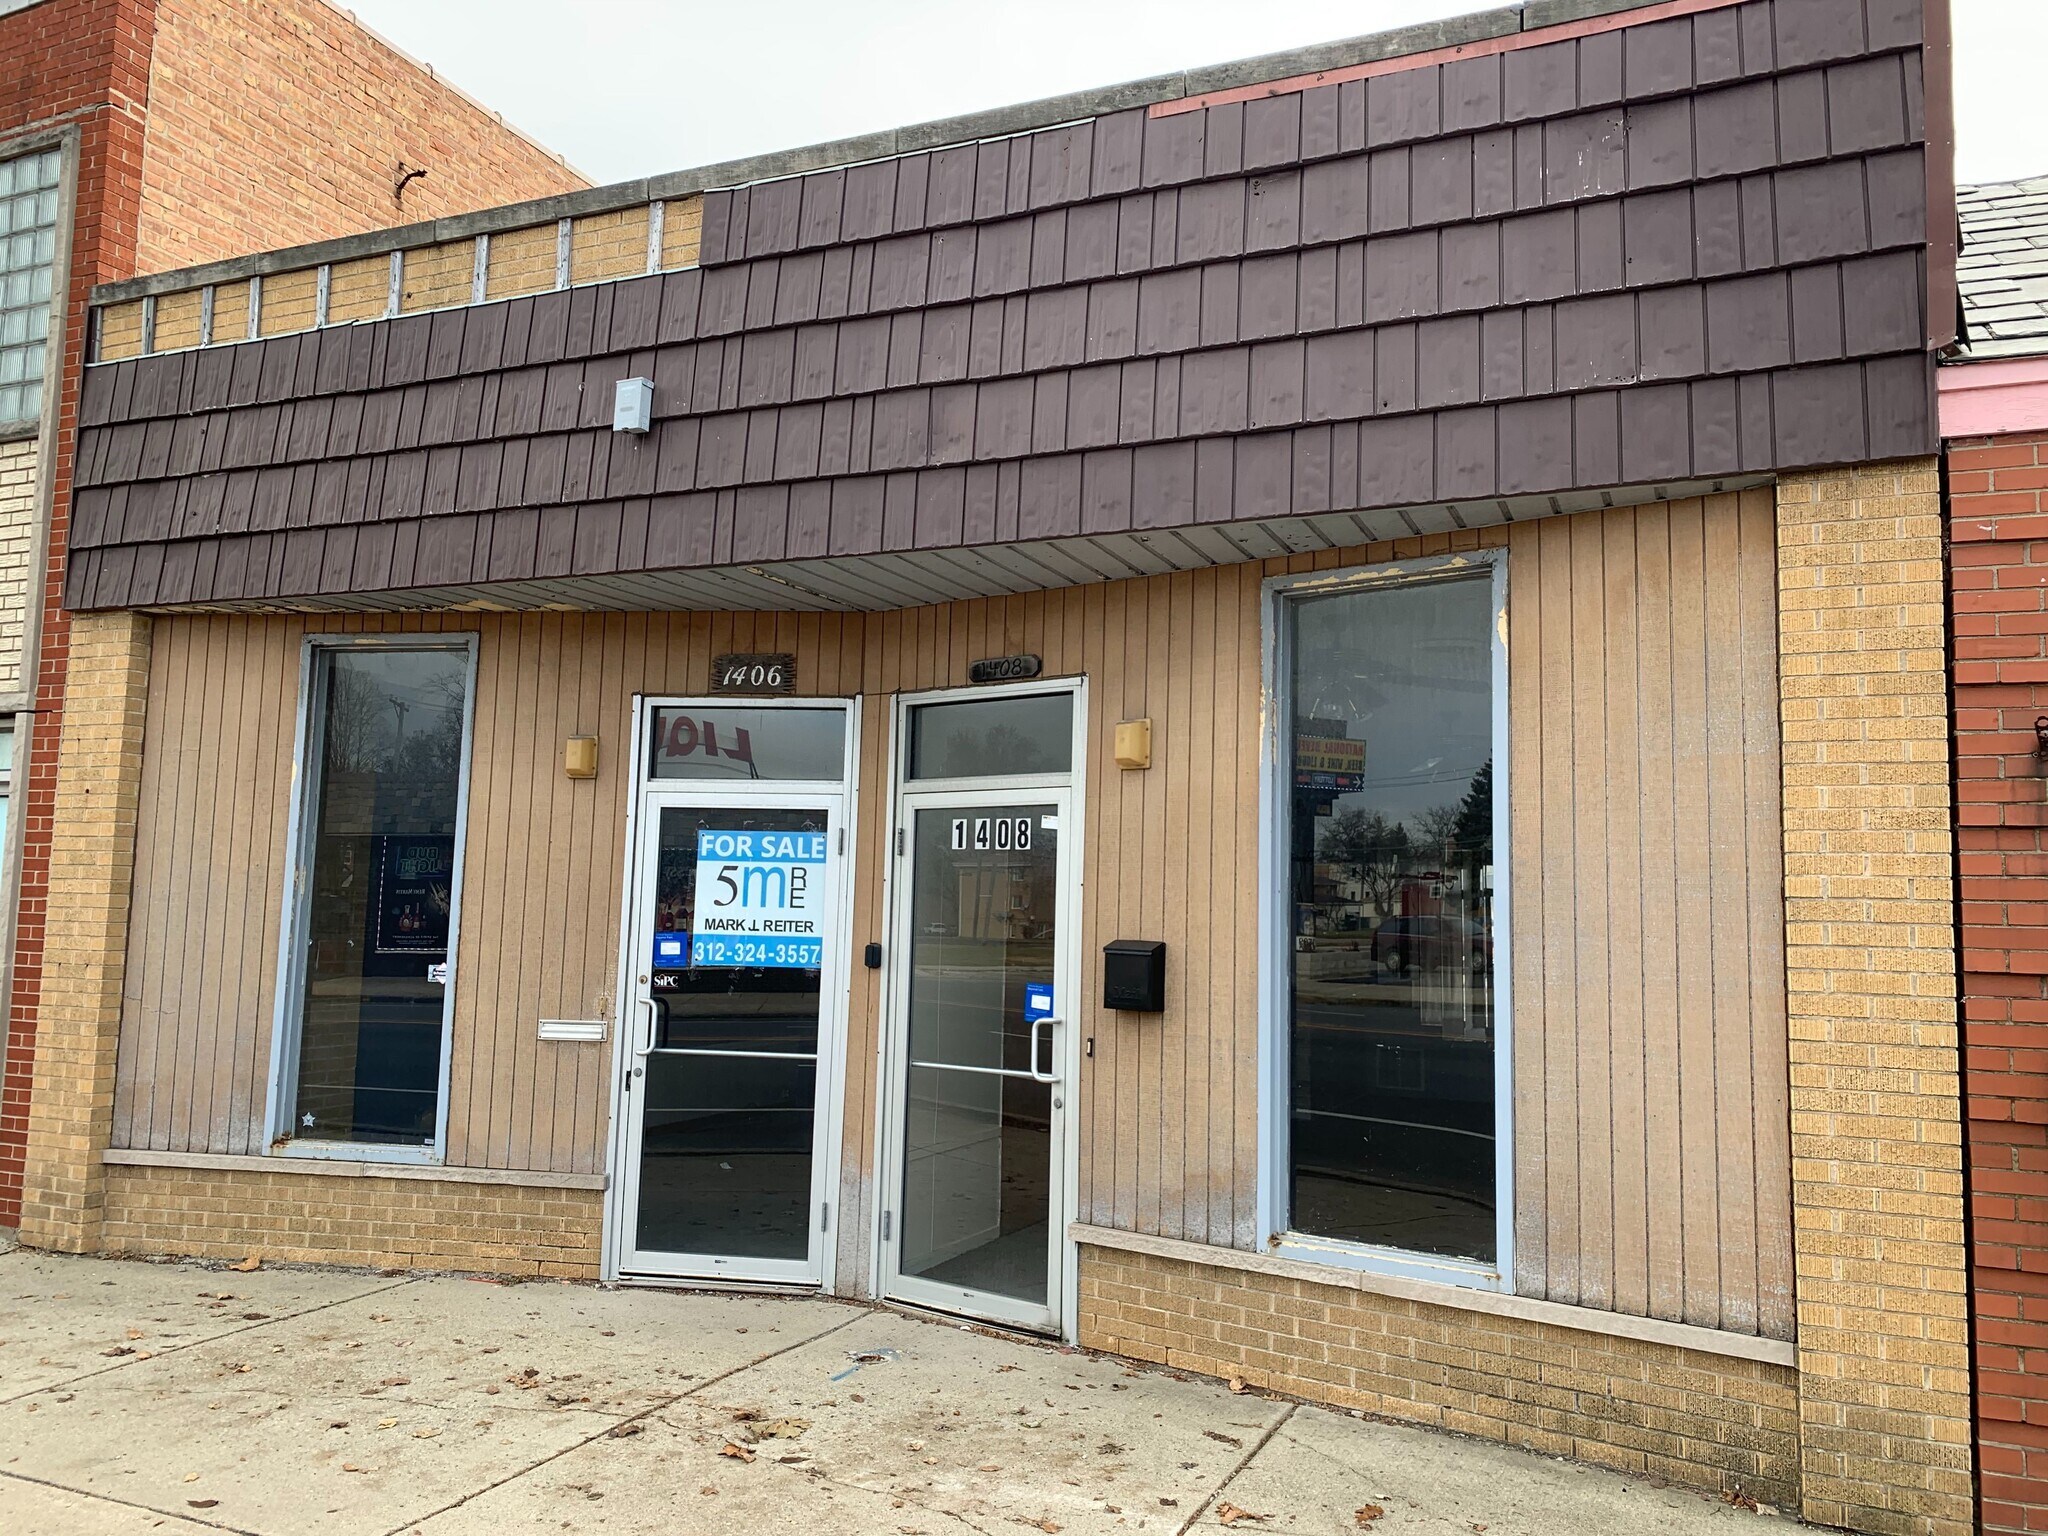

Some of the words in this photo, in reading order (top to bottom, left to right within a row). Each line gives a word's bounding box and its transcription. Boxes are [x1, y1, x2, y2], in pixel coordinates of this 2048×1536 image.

[722, 665, 782, 687] 1406
[982, 658, 1022, 678] 1408
[955, 819, 1029, 849] 1408
[701, 835, 754, 857] FOR
[761, 836, 825, 858] SALE
[704, 918, 746, 931] MARK
[763, 919, 814, 933] REITER
[694, 941, 822, 964] 312-324-3557
